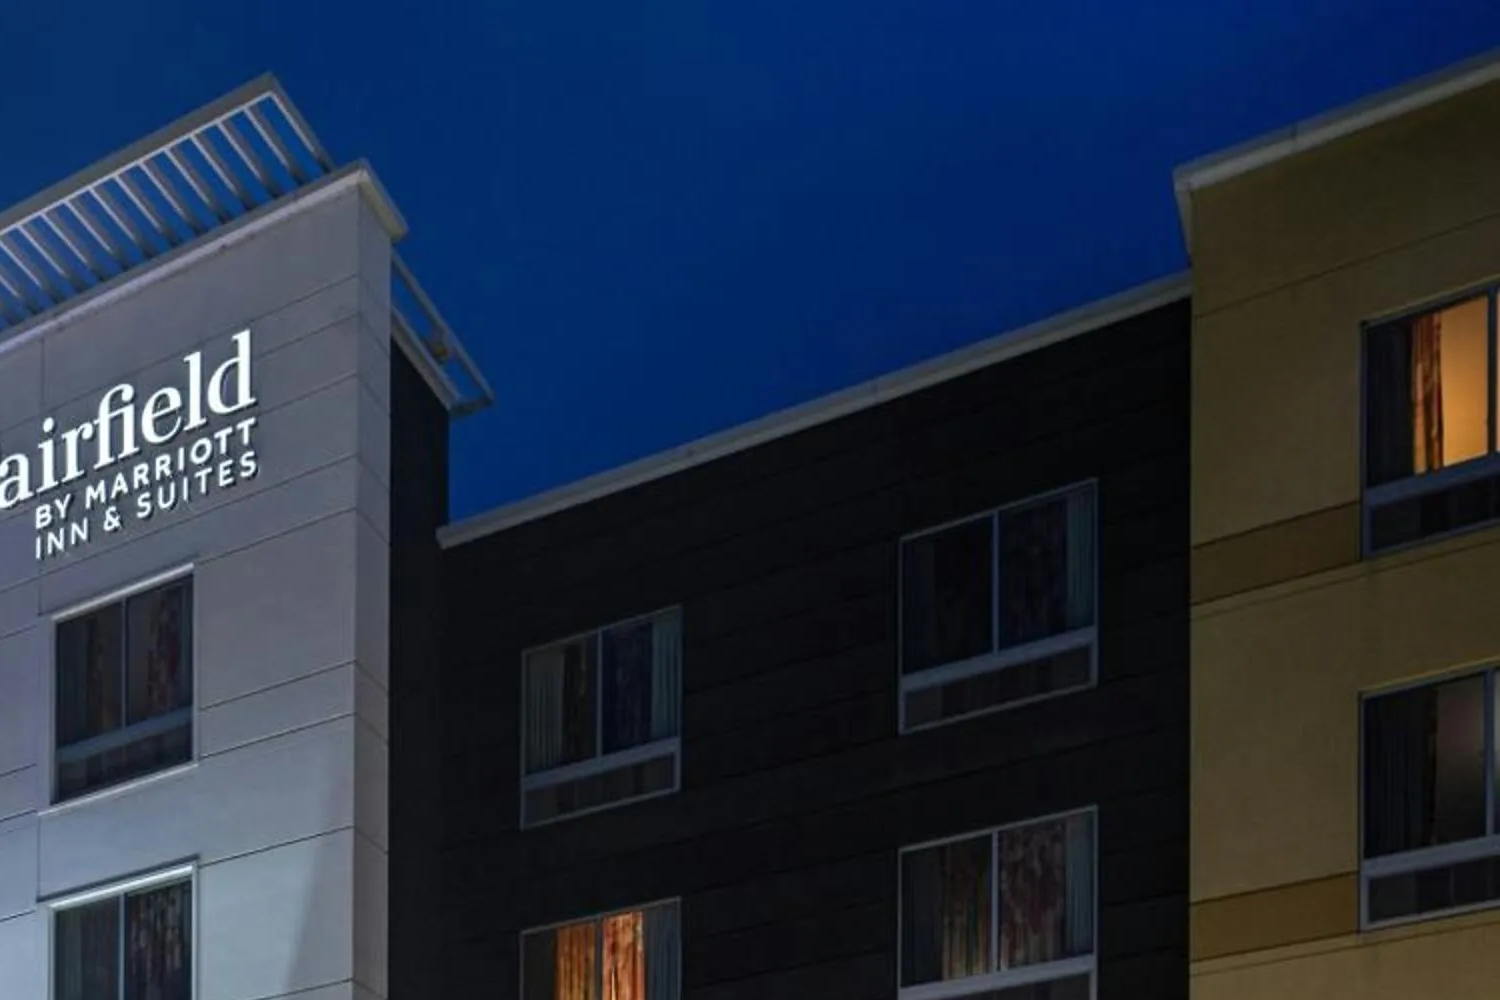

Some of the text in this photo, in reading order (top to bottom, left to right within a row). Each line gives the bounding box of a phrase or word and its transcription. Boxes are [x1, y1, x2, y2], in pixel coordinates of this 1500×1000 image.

[35, 418, 257, 529] BY MARRIOTT
[35, 451, 258, 560] INN & SUITES
